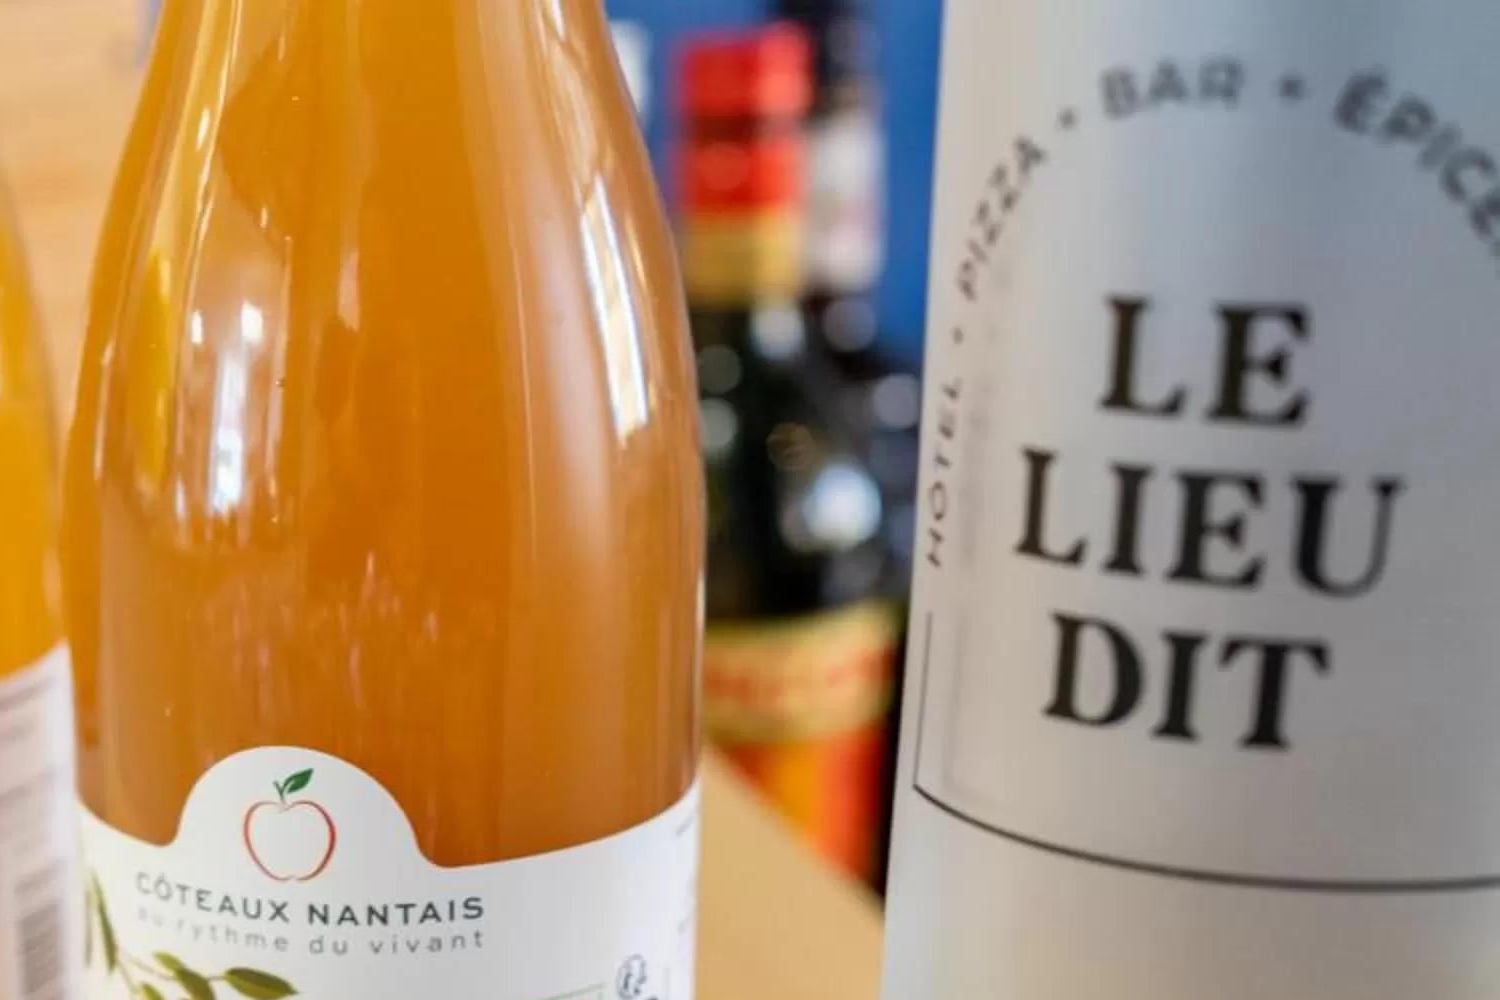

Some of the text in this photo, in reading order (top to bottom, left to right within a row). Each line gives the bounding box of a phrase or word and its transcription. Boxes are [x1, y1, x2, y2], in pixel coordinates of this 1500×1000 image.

[956, 132, 1048, 301] PIZZA
[1100, 60, 1246, 118] BAR
[1332, 62, 1500, 276] ÉPICE
[1098, 295, 1311, 427] LE
[1014, 447, 1406, 599] LIEU
[1043, 610, 1331, 751] DIT
[135, 871, 485, 926] CÔTEAUX NANTAIS
[176, 918, 290, 953] rythme
[308, 935, 349, 956] du
[369, 929, 485, 955] vivant
